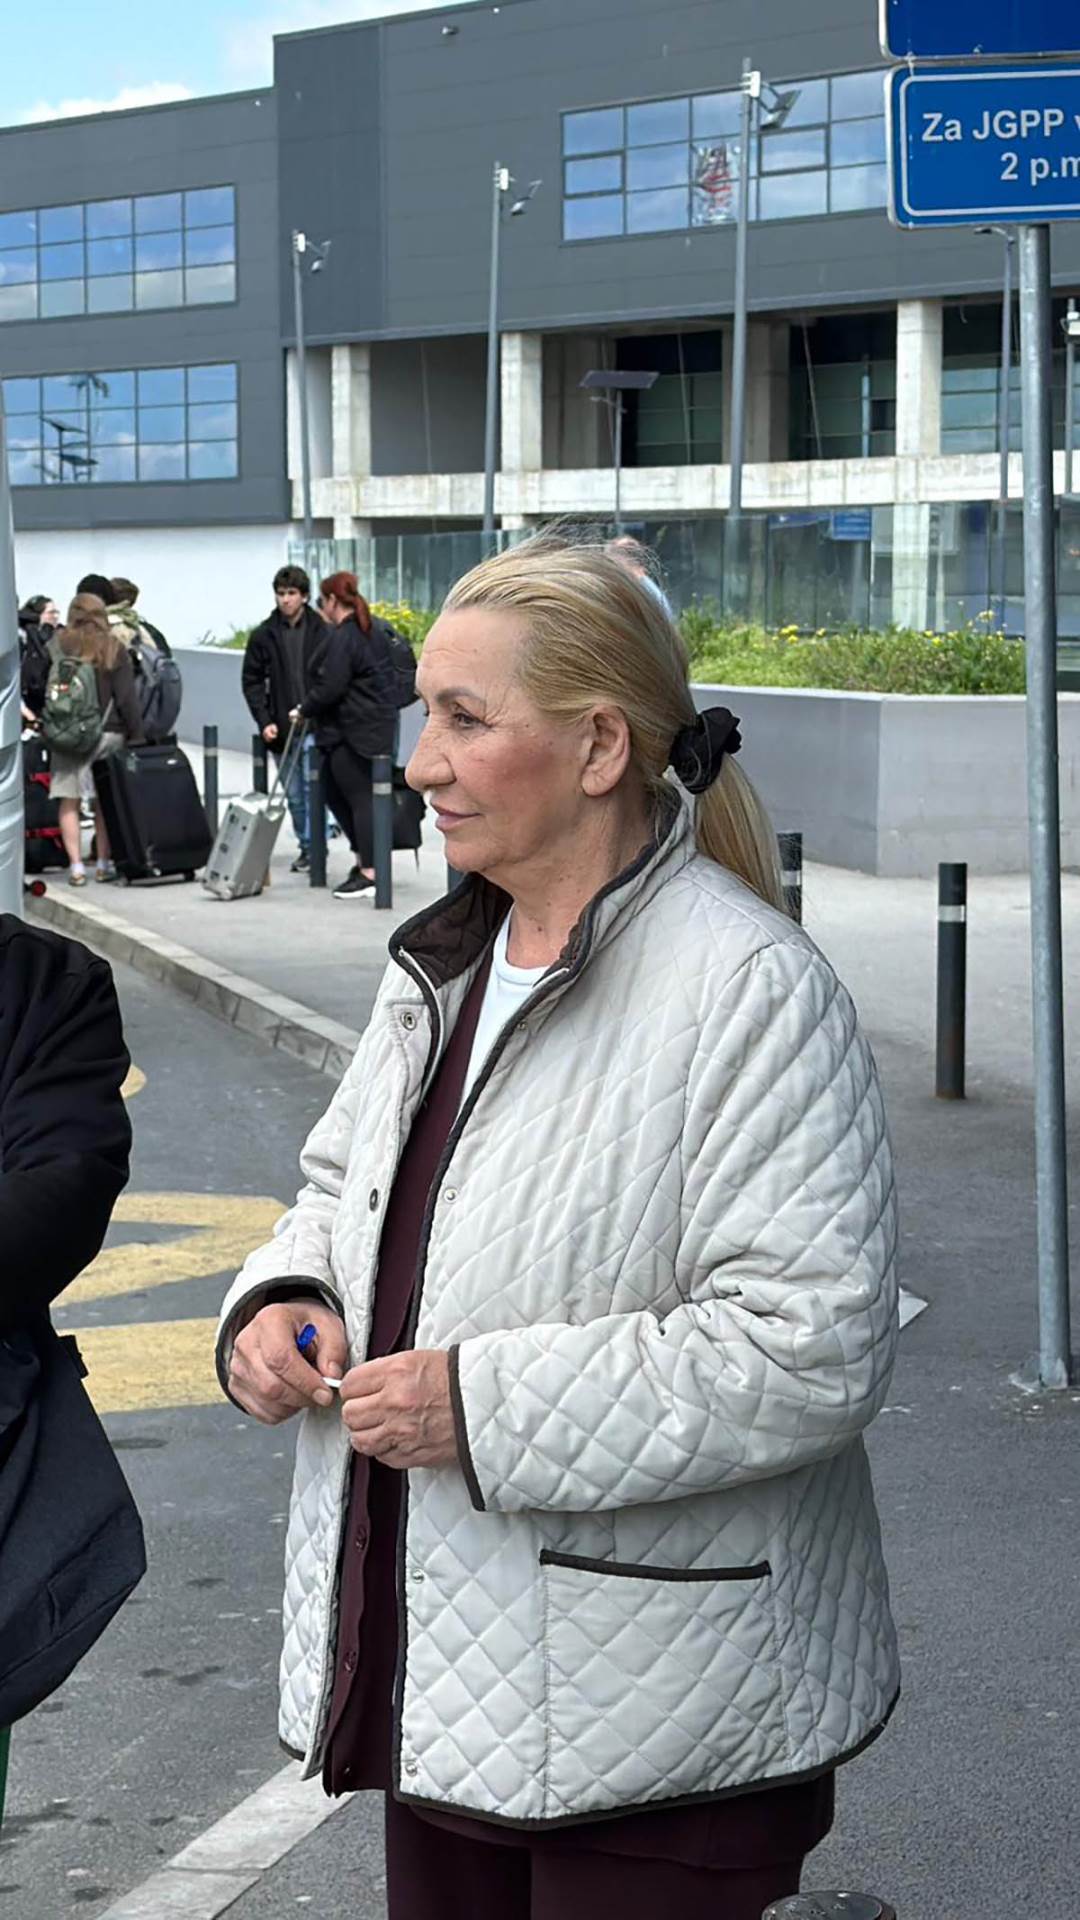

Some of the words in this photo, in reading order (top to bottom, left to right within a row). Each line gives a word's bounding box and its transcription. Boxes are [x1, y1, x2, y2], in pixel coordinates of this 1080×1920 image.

[921, 112, 962, 142] Za
[972, 108, 1064, 140] JGPP
[1000, 152, 1018, 180] 2
